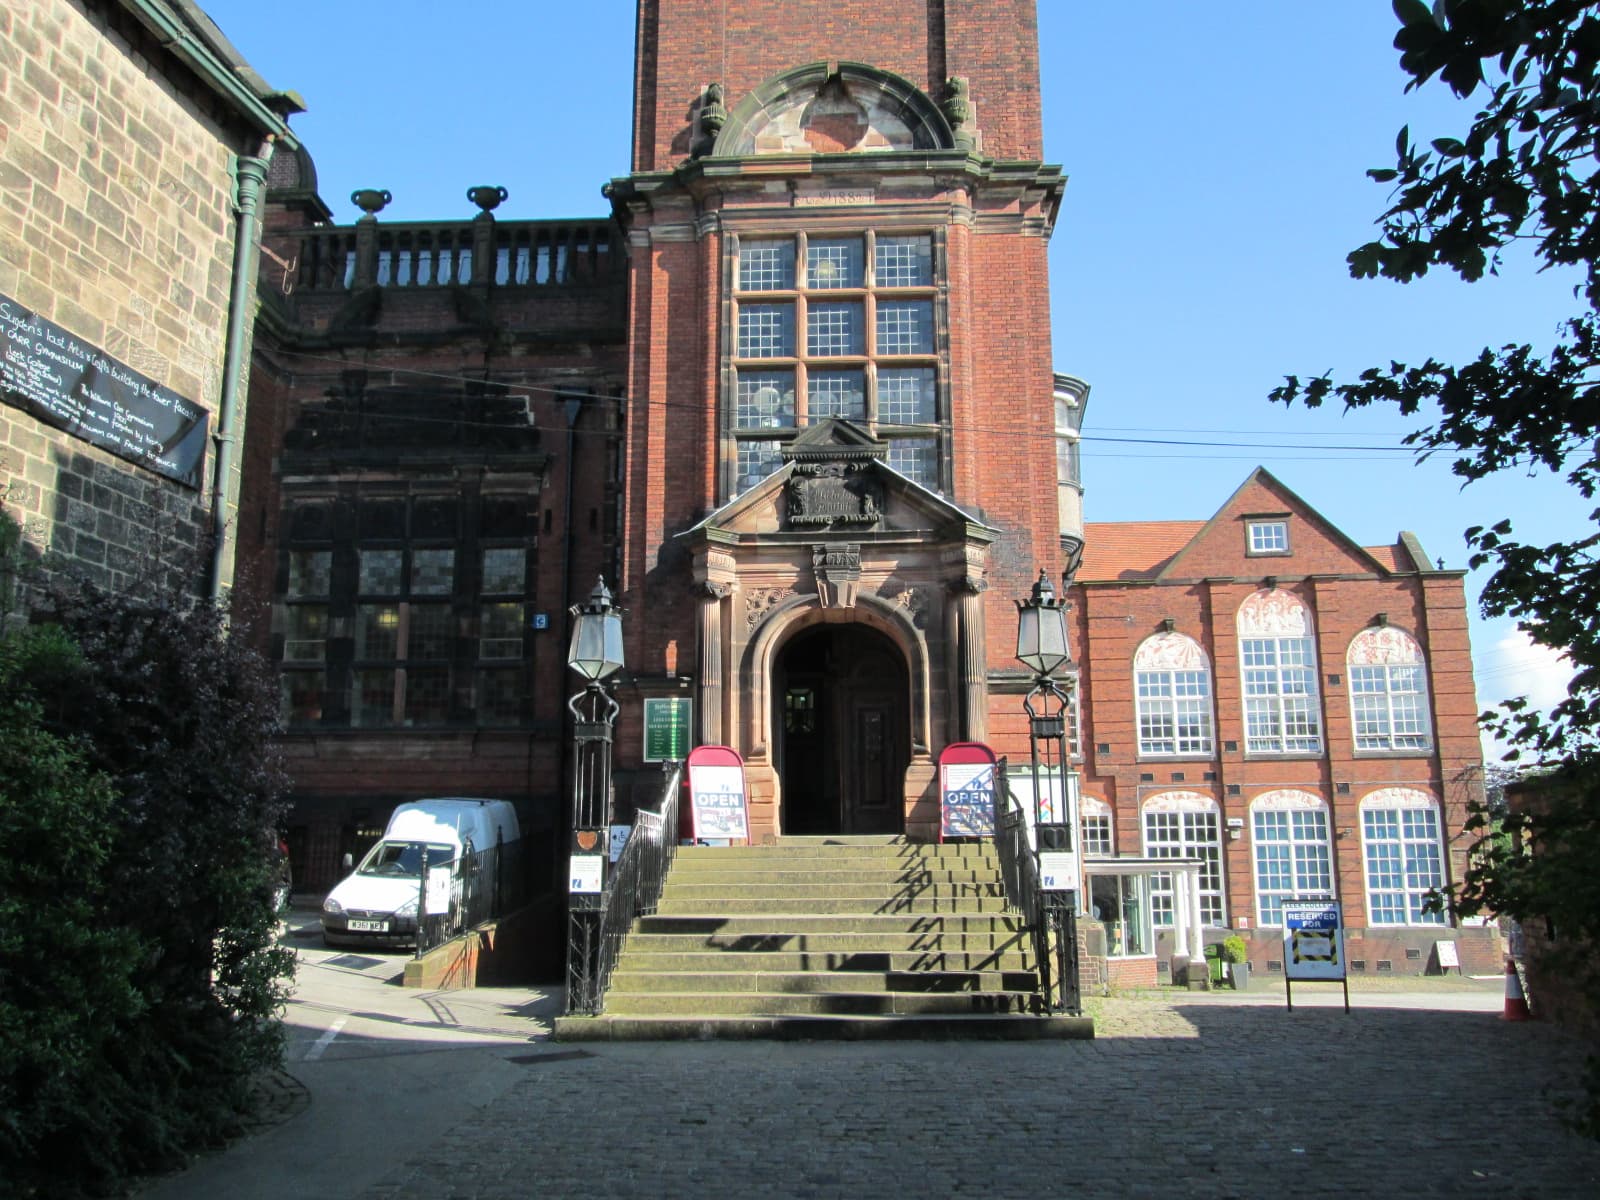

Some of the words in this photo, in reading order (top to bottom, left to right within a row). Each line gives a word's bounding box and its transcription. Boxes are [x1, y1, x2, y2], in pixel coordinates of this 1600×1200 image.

[111, 367, 140, 396] building
[698, 794, 740, 806] OPEN
[947, 792, 990, 804] OPEN
[1287, 912, 1336, 920] RESERVED
[1302, 920, 1321, 928] FOR
